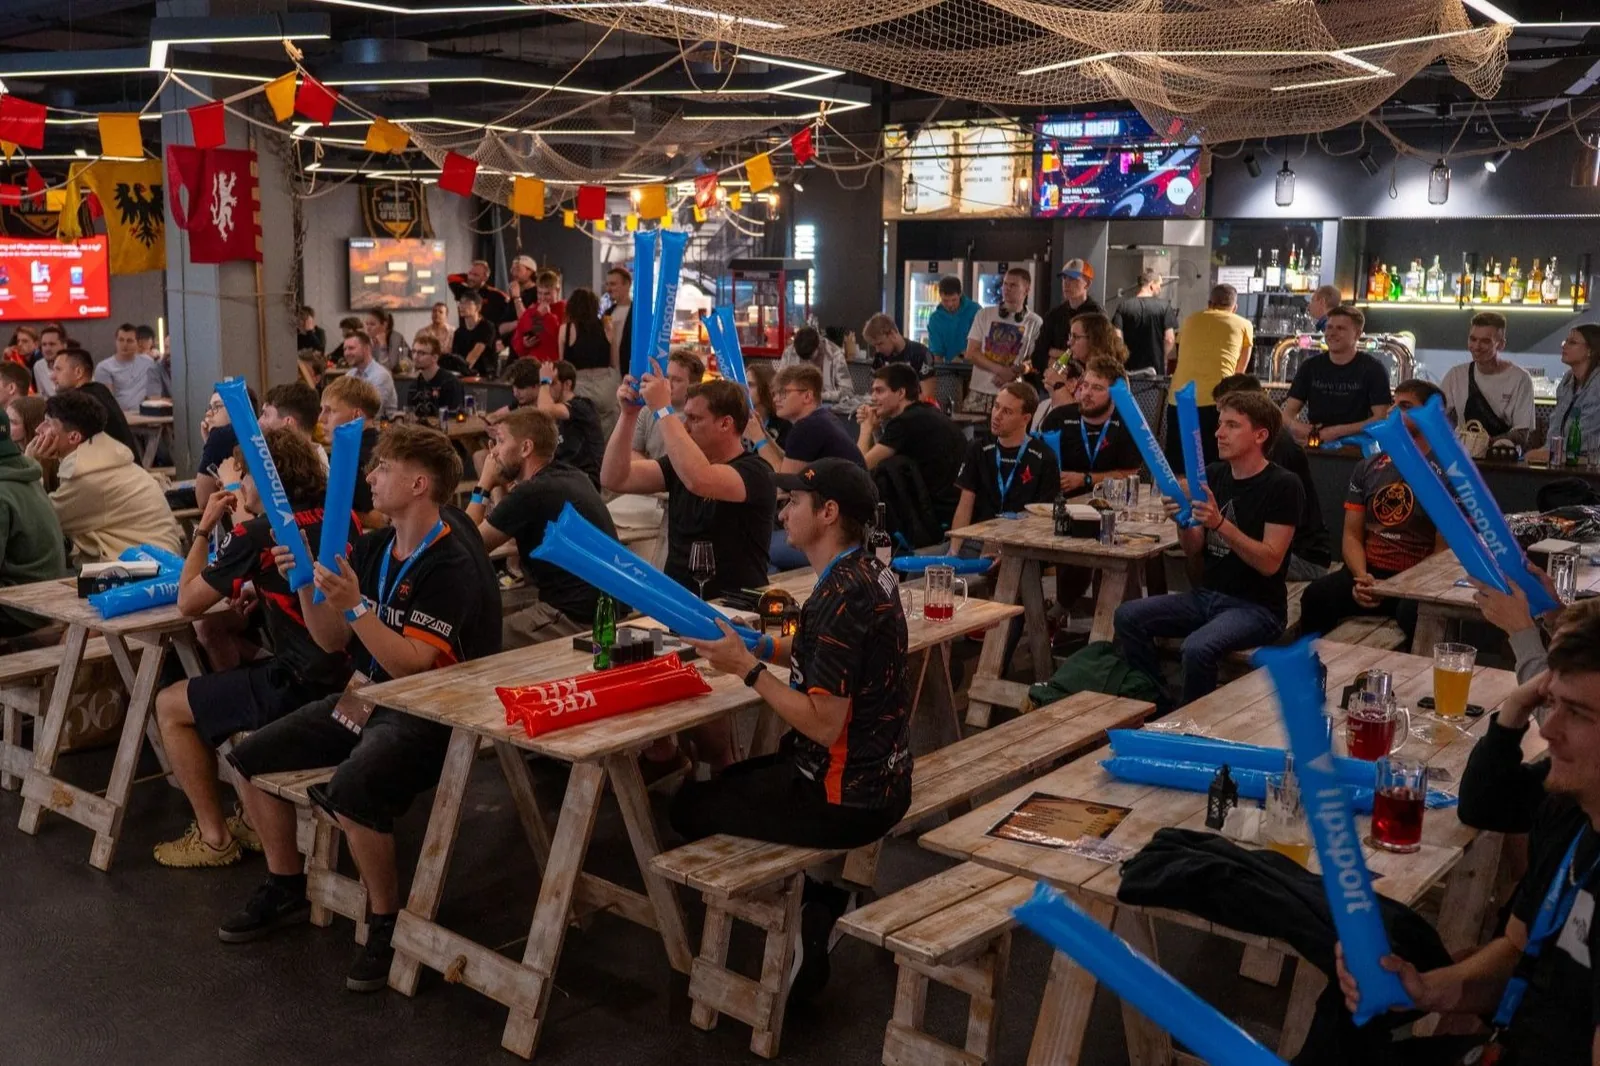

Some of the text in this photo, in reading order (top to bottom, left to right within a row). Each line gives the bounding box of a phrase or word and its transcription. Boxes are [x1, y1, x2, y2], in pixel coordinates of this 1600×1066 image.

[658, 284, 677, 343] Tipsport
[250, 434, 288, 507] Tipsport
[1145, 432, 1176, 484] Tipsport
[1456, 480, 1508, 556] Tipsport
[550, 690, 597, 716] KFC
